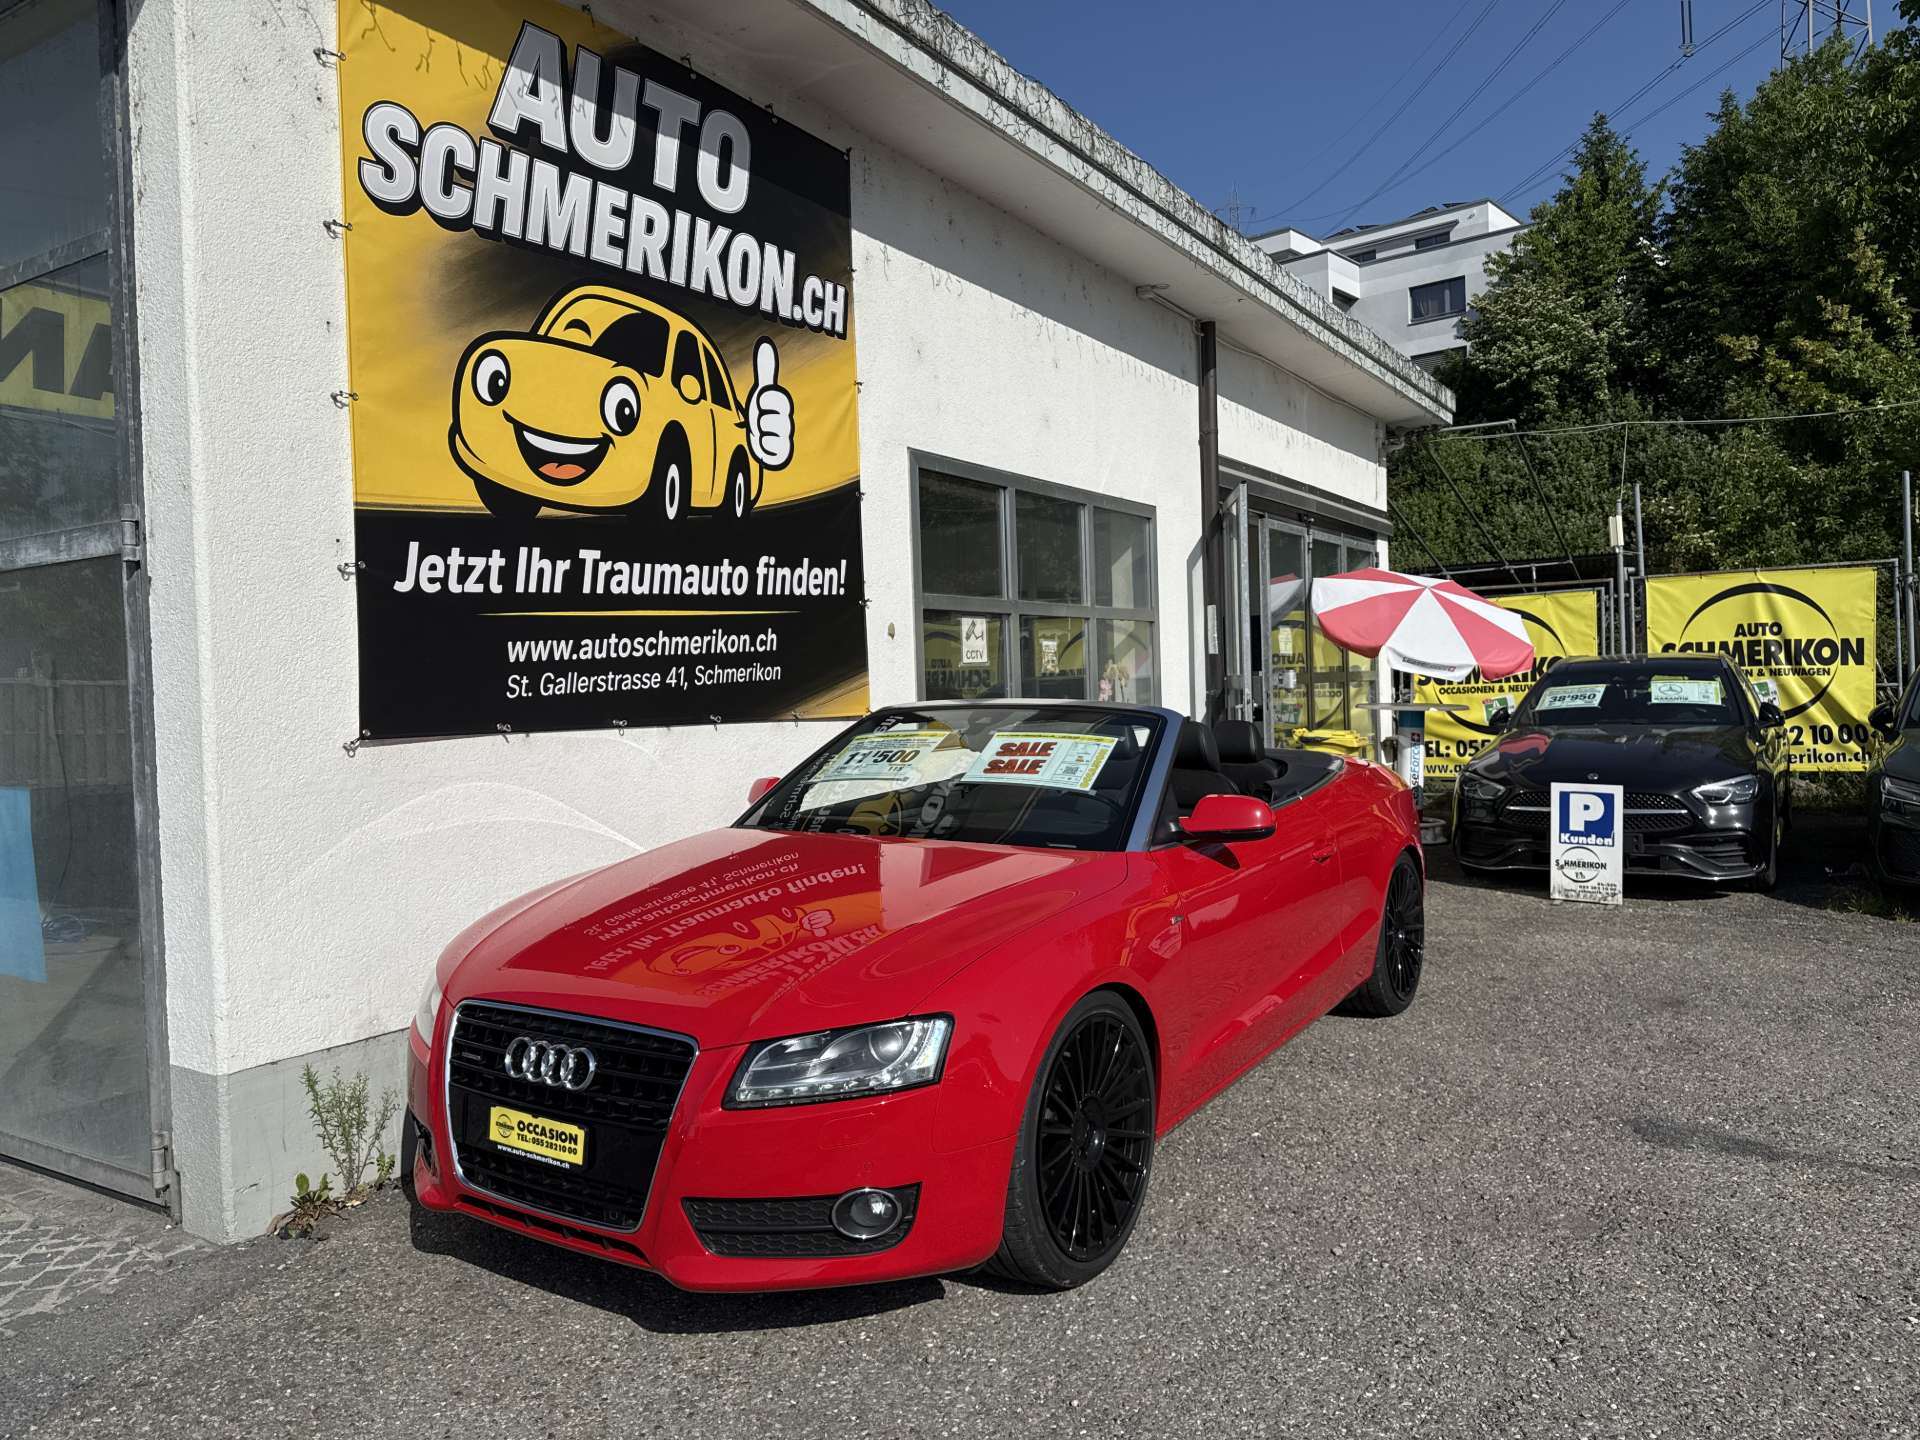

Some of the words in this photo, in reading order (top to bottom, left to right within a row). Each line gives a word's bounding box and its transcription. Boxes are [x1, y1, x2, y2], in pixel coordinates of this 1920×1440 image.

[489, 20, 752, 214] AUTO
[360, 102, 847, 335] SCHMERIKON.CH
[393, 541, 506, 594] Jetzt
[516, 546, 570, 594] Ihr
[578, 549, 749, 596] Traumauto
[755, 555, 847, 596] finden!
[1734, 622, 1783, 637] AUTO
[507, 629, 778, 663] www.autoschmerikon.ch
[965, 649, 984, 660] CCTV
[1757, 667, 1765, 677] &
[1769, 667, 1831, 677] NEUWAGEN
[506, 675, 533, 699] St.
[540, 667, 661, 695] Gallerstrasse
[666, 667, 689, 691] 41,
[694, 663, 781, 686] Schmerikon
[1439, 685, 1495, 695] OCCASIONEN
[1809, 725, 1834, 745] 10
[1837, 724, 1869, 745] 00
[996, 741, 1057, 757] SALE
[1424, 740, 1451, 758] EL:
[1787, 749, 1872, 764] erikon.ch
[983, 759, 1047, 774] SALE
[1569, 792, 1605, 831] P
[1560, 833, 1614, 846] Kunden
[1555, 859, 1607, 870] SHMERIKON
[517, 1120, 578, 1146] OCCASION
